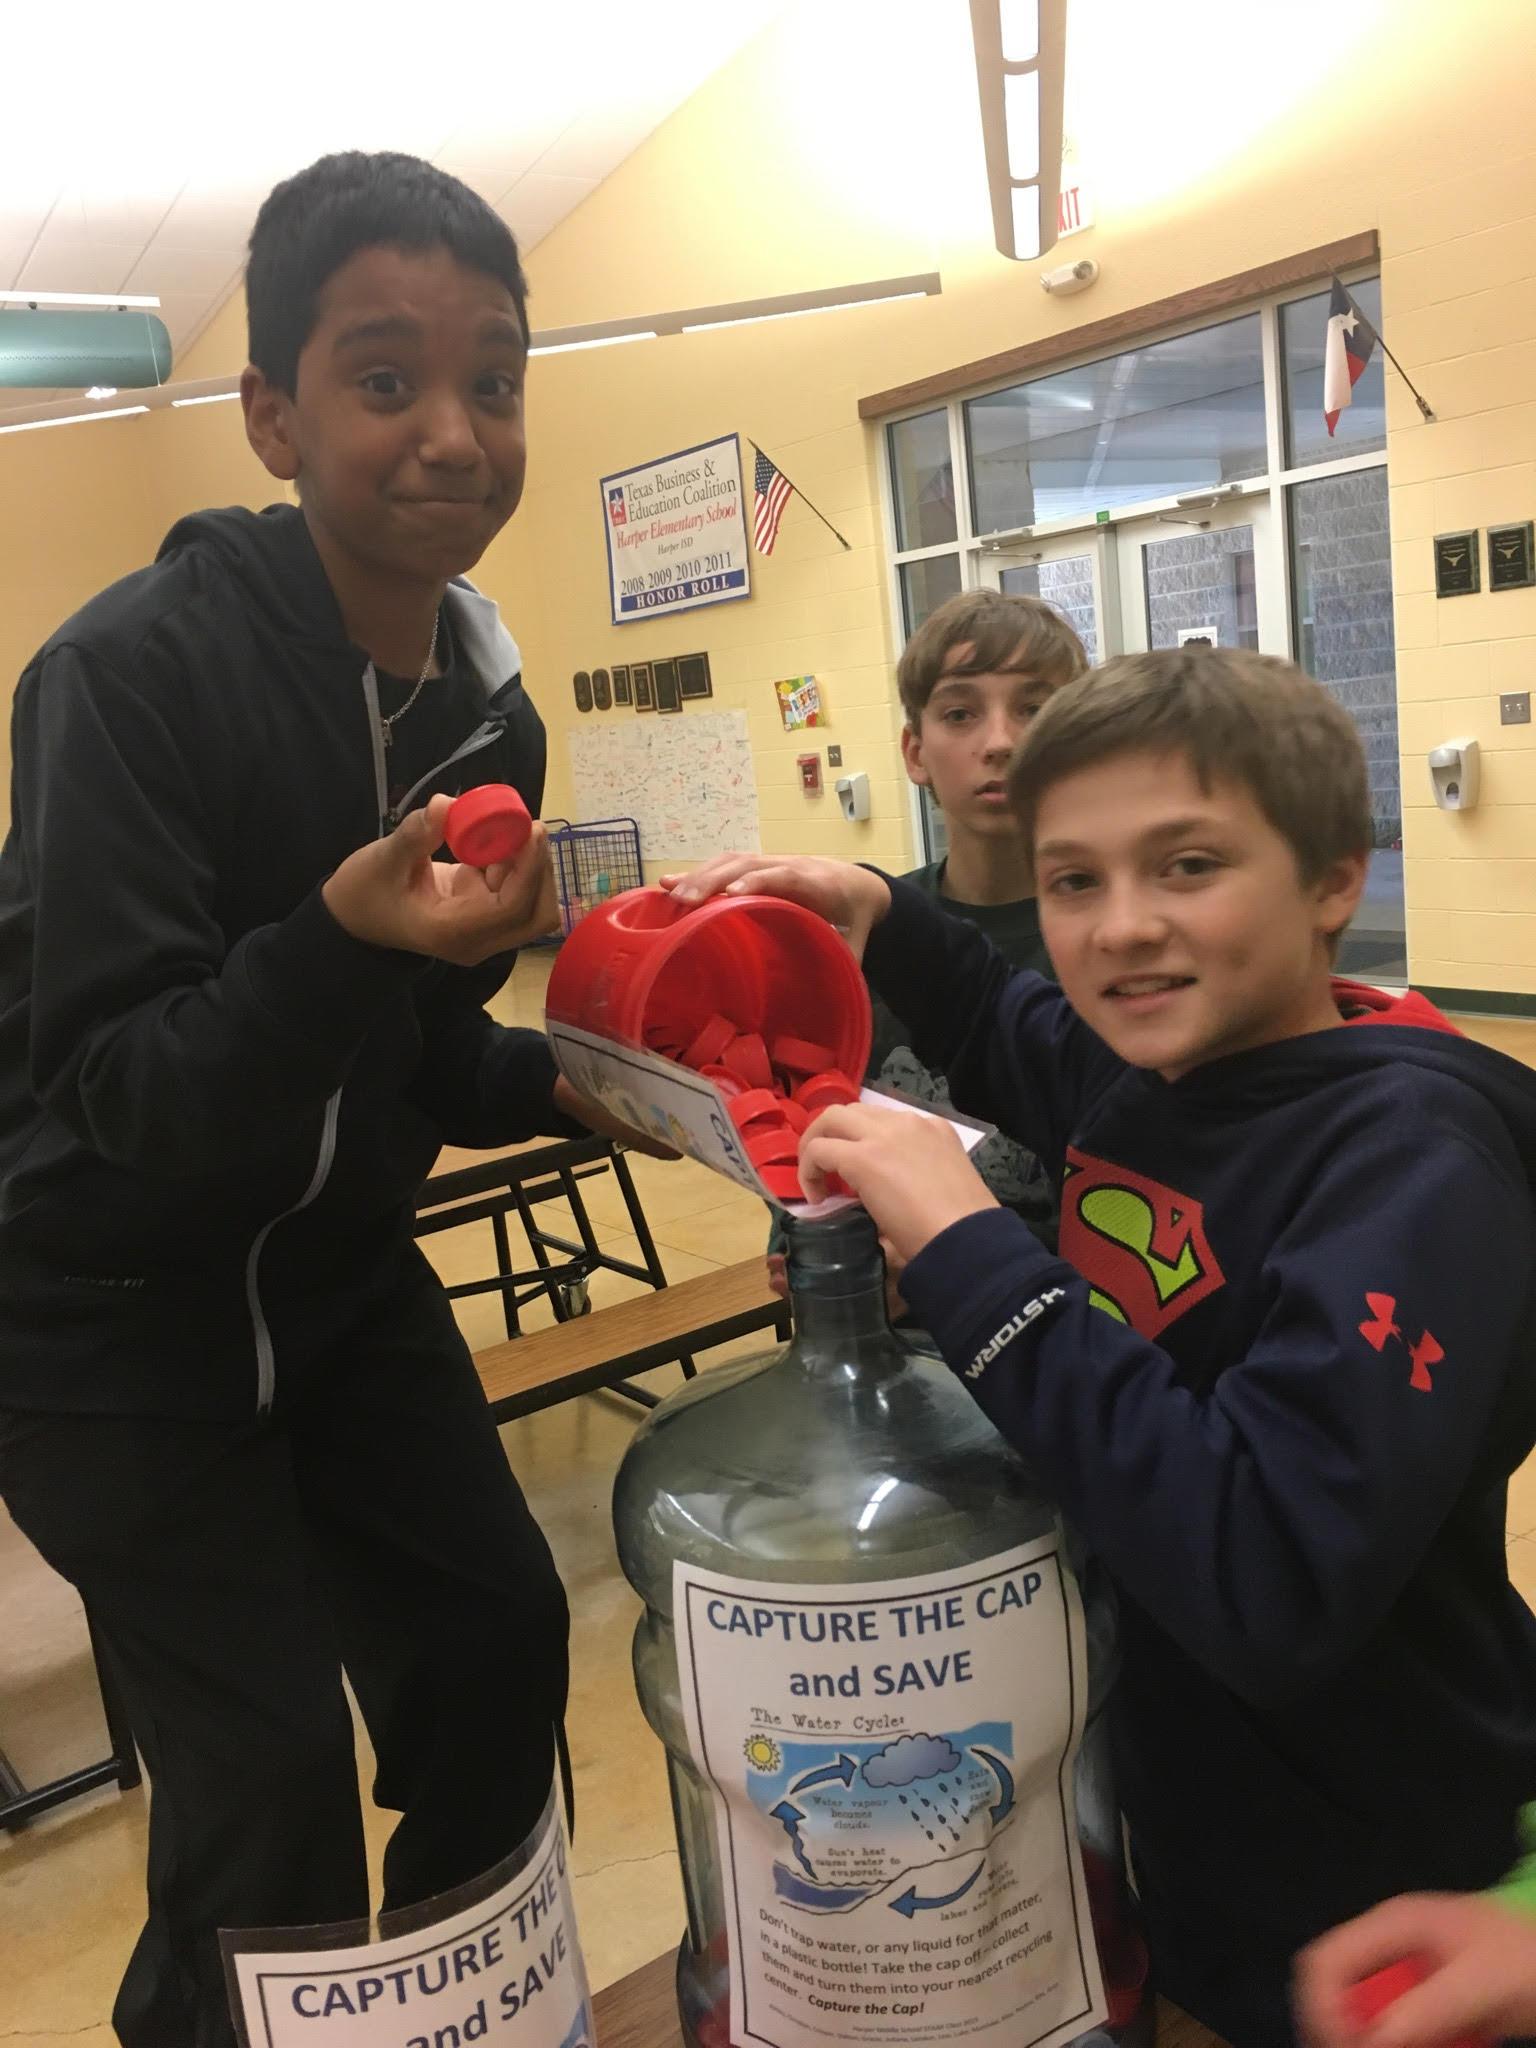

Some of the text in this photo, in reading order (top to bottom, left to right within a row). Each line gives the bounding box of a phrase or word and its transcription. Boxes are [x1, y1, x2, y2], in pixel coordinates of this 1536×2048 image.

[1056, 186, 1080, 232] XIT
[624, 459, 716, 503] Texas Business &
[628, 479, 737, 522] Education Coalition
[616, 497, 737, 549] Harper Elementary School
[658, 537, 694, 556] Harper ISD
[621, 551, 732, 596] 2008 2009 2010 2011
[636, 575, 730, 609] HONOR ROLL
[964, 1298, 1045, 1379] STORM
[706, 1571, 1042, 1643] CAPTURE THE CAP
[789, 1650, 974, 1698] and SAVE
[751, 1707, 905, 1733] The Water Cycle:
[812, 1795, 843, 1808] Water
[831, 1808, 873, 1819] becomes
[815, 1856, 901, 1868] causes water to
[827, 1847, 886, 1858] Sun's heat
[291, 1864, 558, 2019] CAPTURE THE
[759, 1893, 1043, 1955] Don't trap water, or any liquid for that matter,
[760, 1930, 770, 1944] in
[772, 1940, 779, 1949] a
[781, 1944, 818, 1968] plastic
[821, 1957, 868, 1974] bottle!
[872, 1961, 905, 1974] Take
[908, 1960, 933, 1974] the
[936, 1959, 961, 1972] cap
[964, 1949, 982, 1967] off
[992, 1921, 1030, 1950] collect
[762, 1930, 1054, 1995] them and turn them into your nearest recycling
[405, 1921, 567, 2048] and SAVE
[764, 1972, 925, 2017] center. Capture the Cap!
